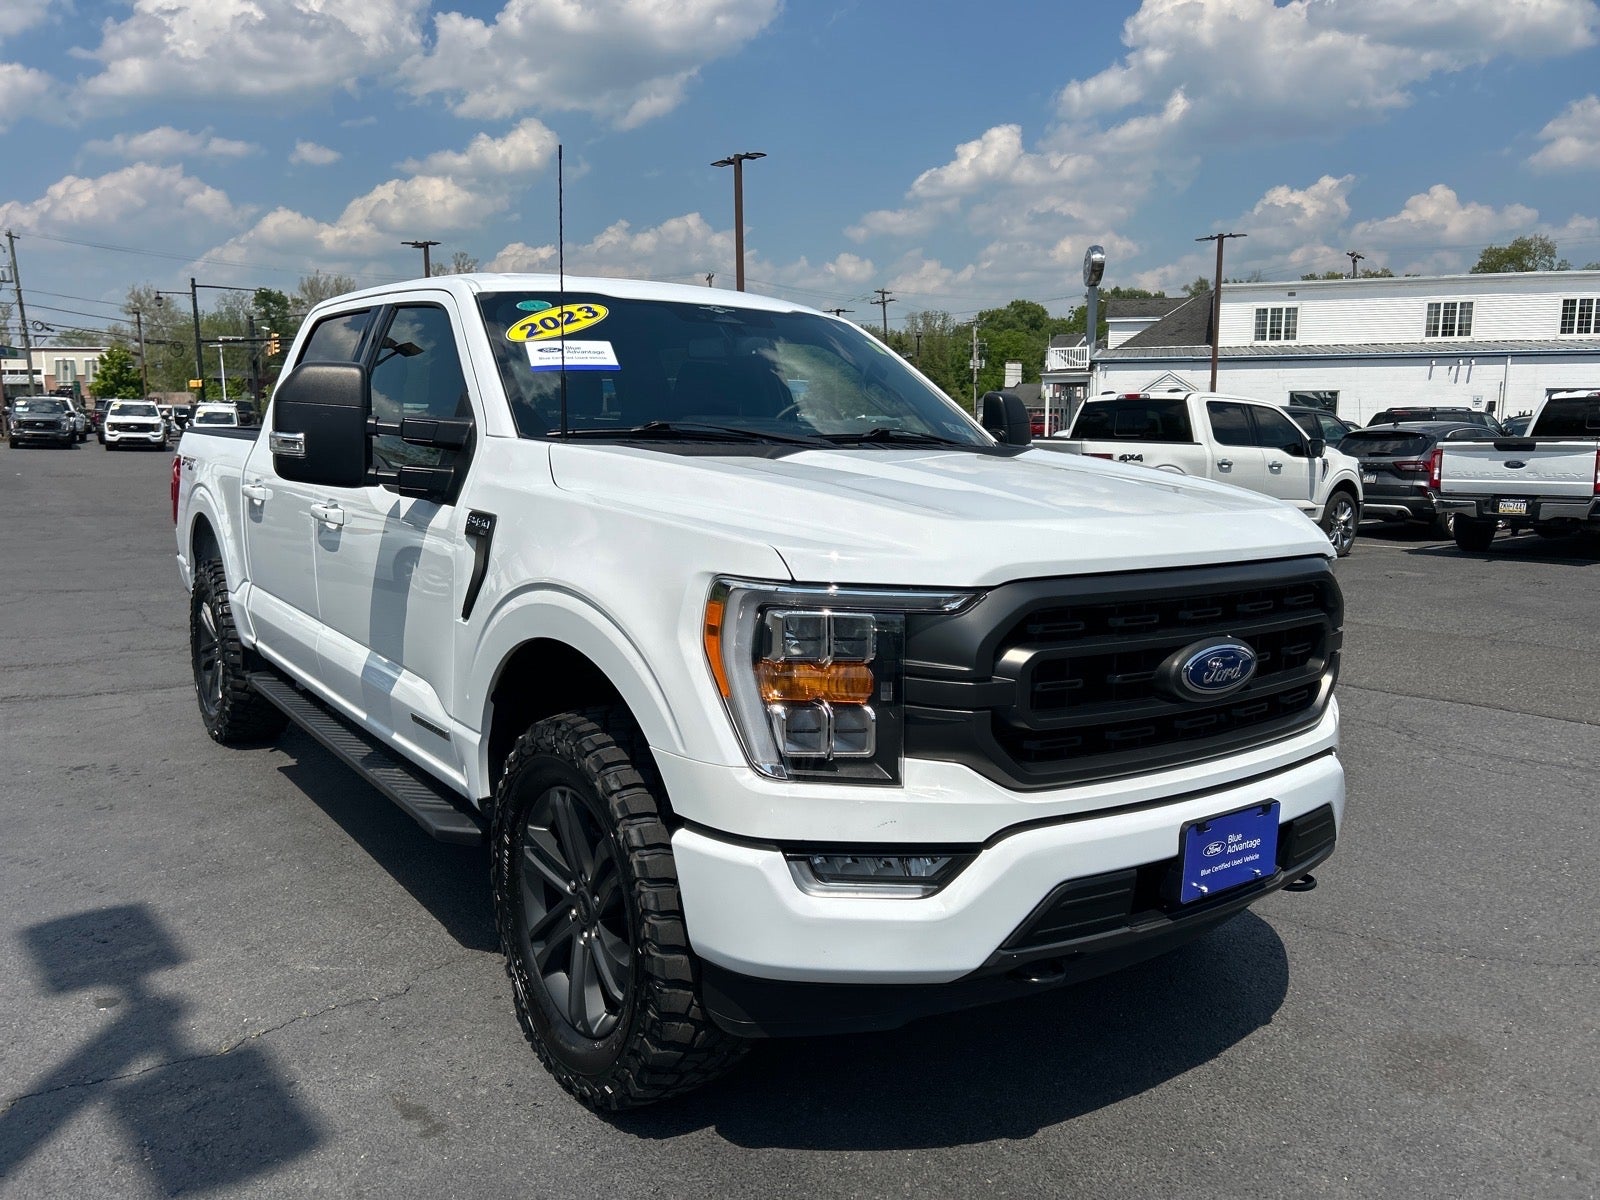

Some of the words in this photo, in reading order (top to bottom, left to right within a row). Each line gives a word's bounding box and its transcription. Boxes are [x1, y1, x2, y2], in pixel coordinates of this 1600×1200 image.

[519, 305, 599, 339] 2023
[1449, 470, 1519, 479] SUPER
[1527, 471, 1586, 480] DUTY
[1203, 655, 1243, 684] Ford
[1226, 838, 1261, 855] Advantage
[1227, 833, 1243, 844] Blue
[1206, 843, 1222, 856] Ford
[1200, 868, 1212, 877] Blue
[1211, 861, 1231, 873] Certified
[1231, 857, 1243, 867] Used
[1243, 853, 1260, 863] Vehicle
